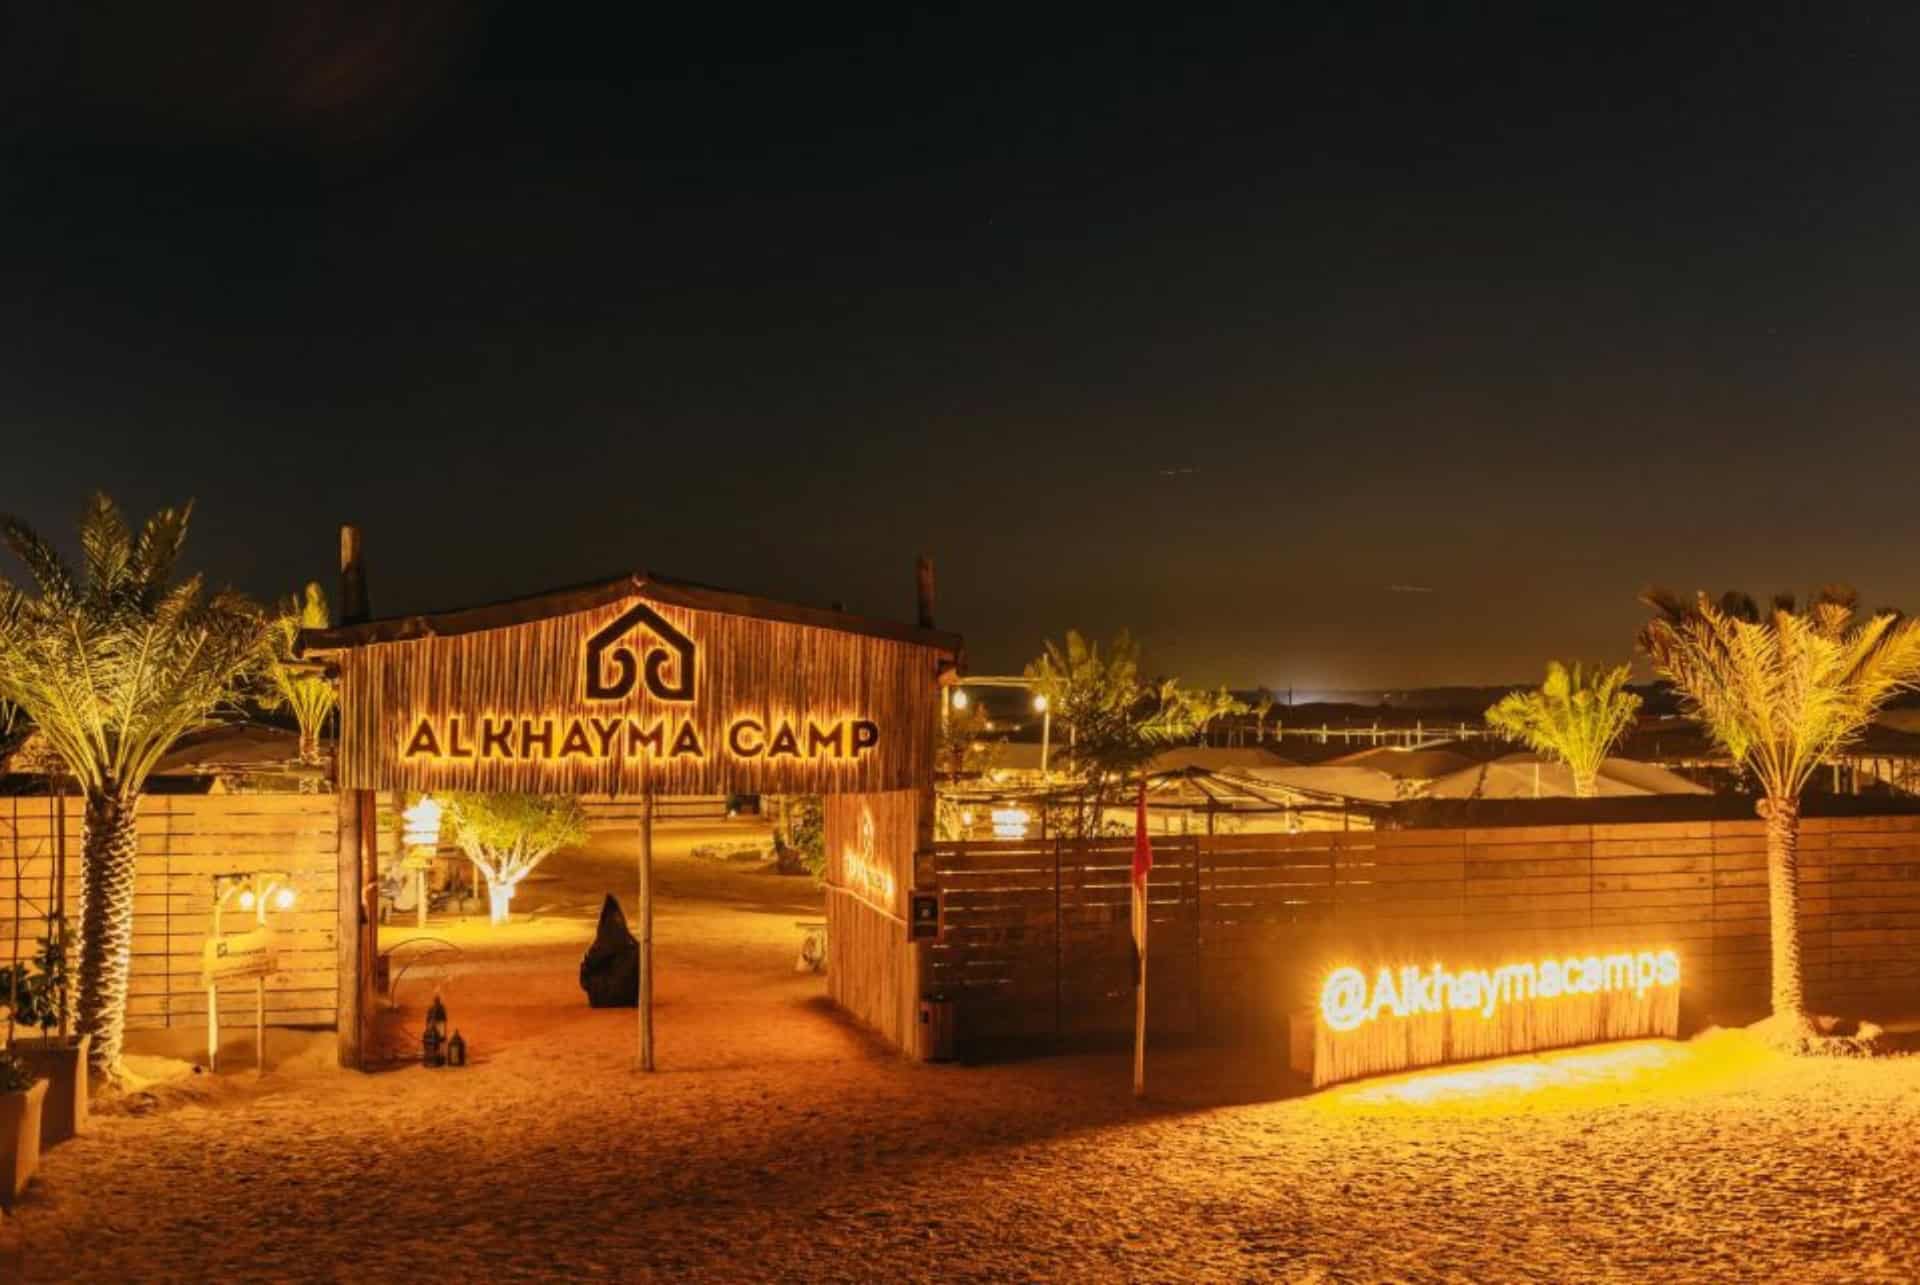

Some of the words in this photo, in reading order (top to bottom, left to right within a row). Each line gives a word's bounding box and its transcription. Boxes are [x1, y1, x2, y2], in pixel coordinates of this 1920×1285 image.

[405, 718, 704, 758] ALKHAYMA
[728, 719, 879, 758] CAMP
[1319, 950, 1681, 1031] @Alkhaymacamps
